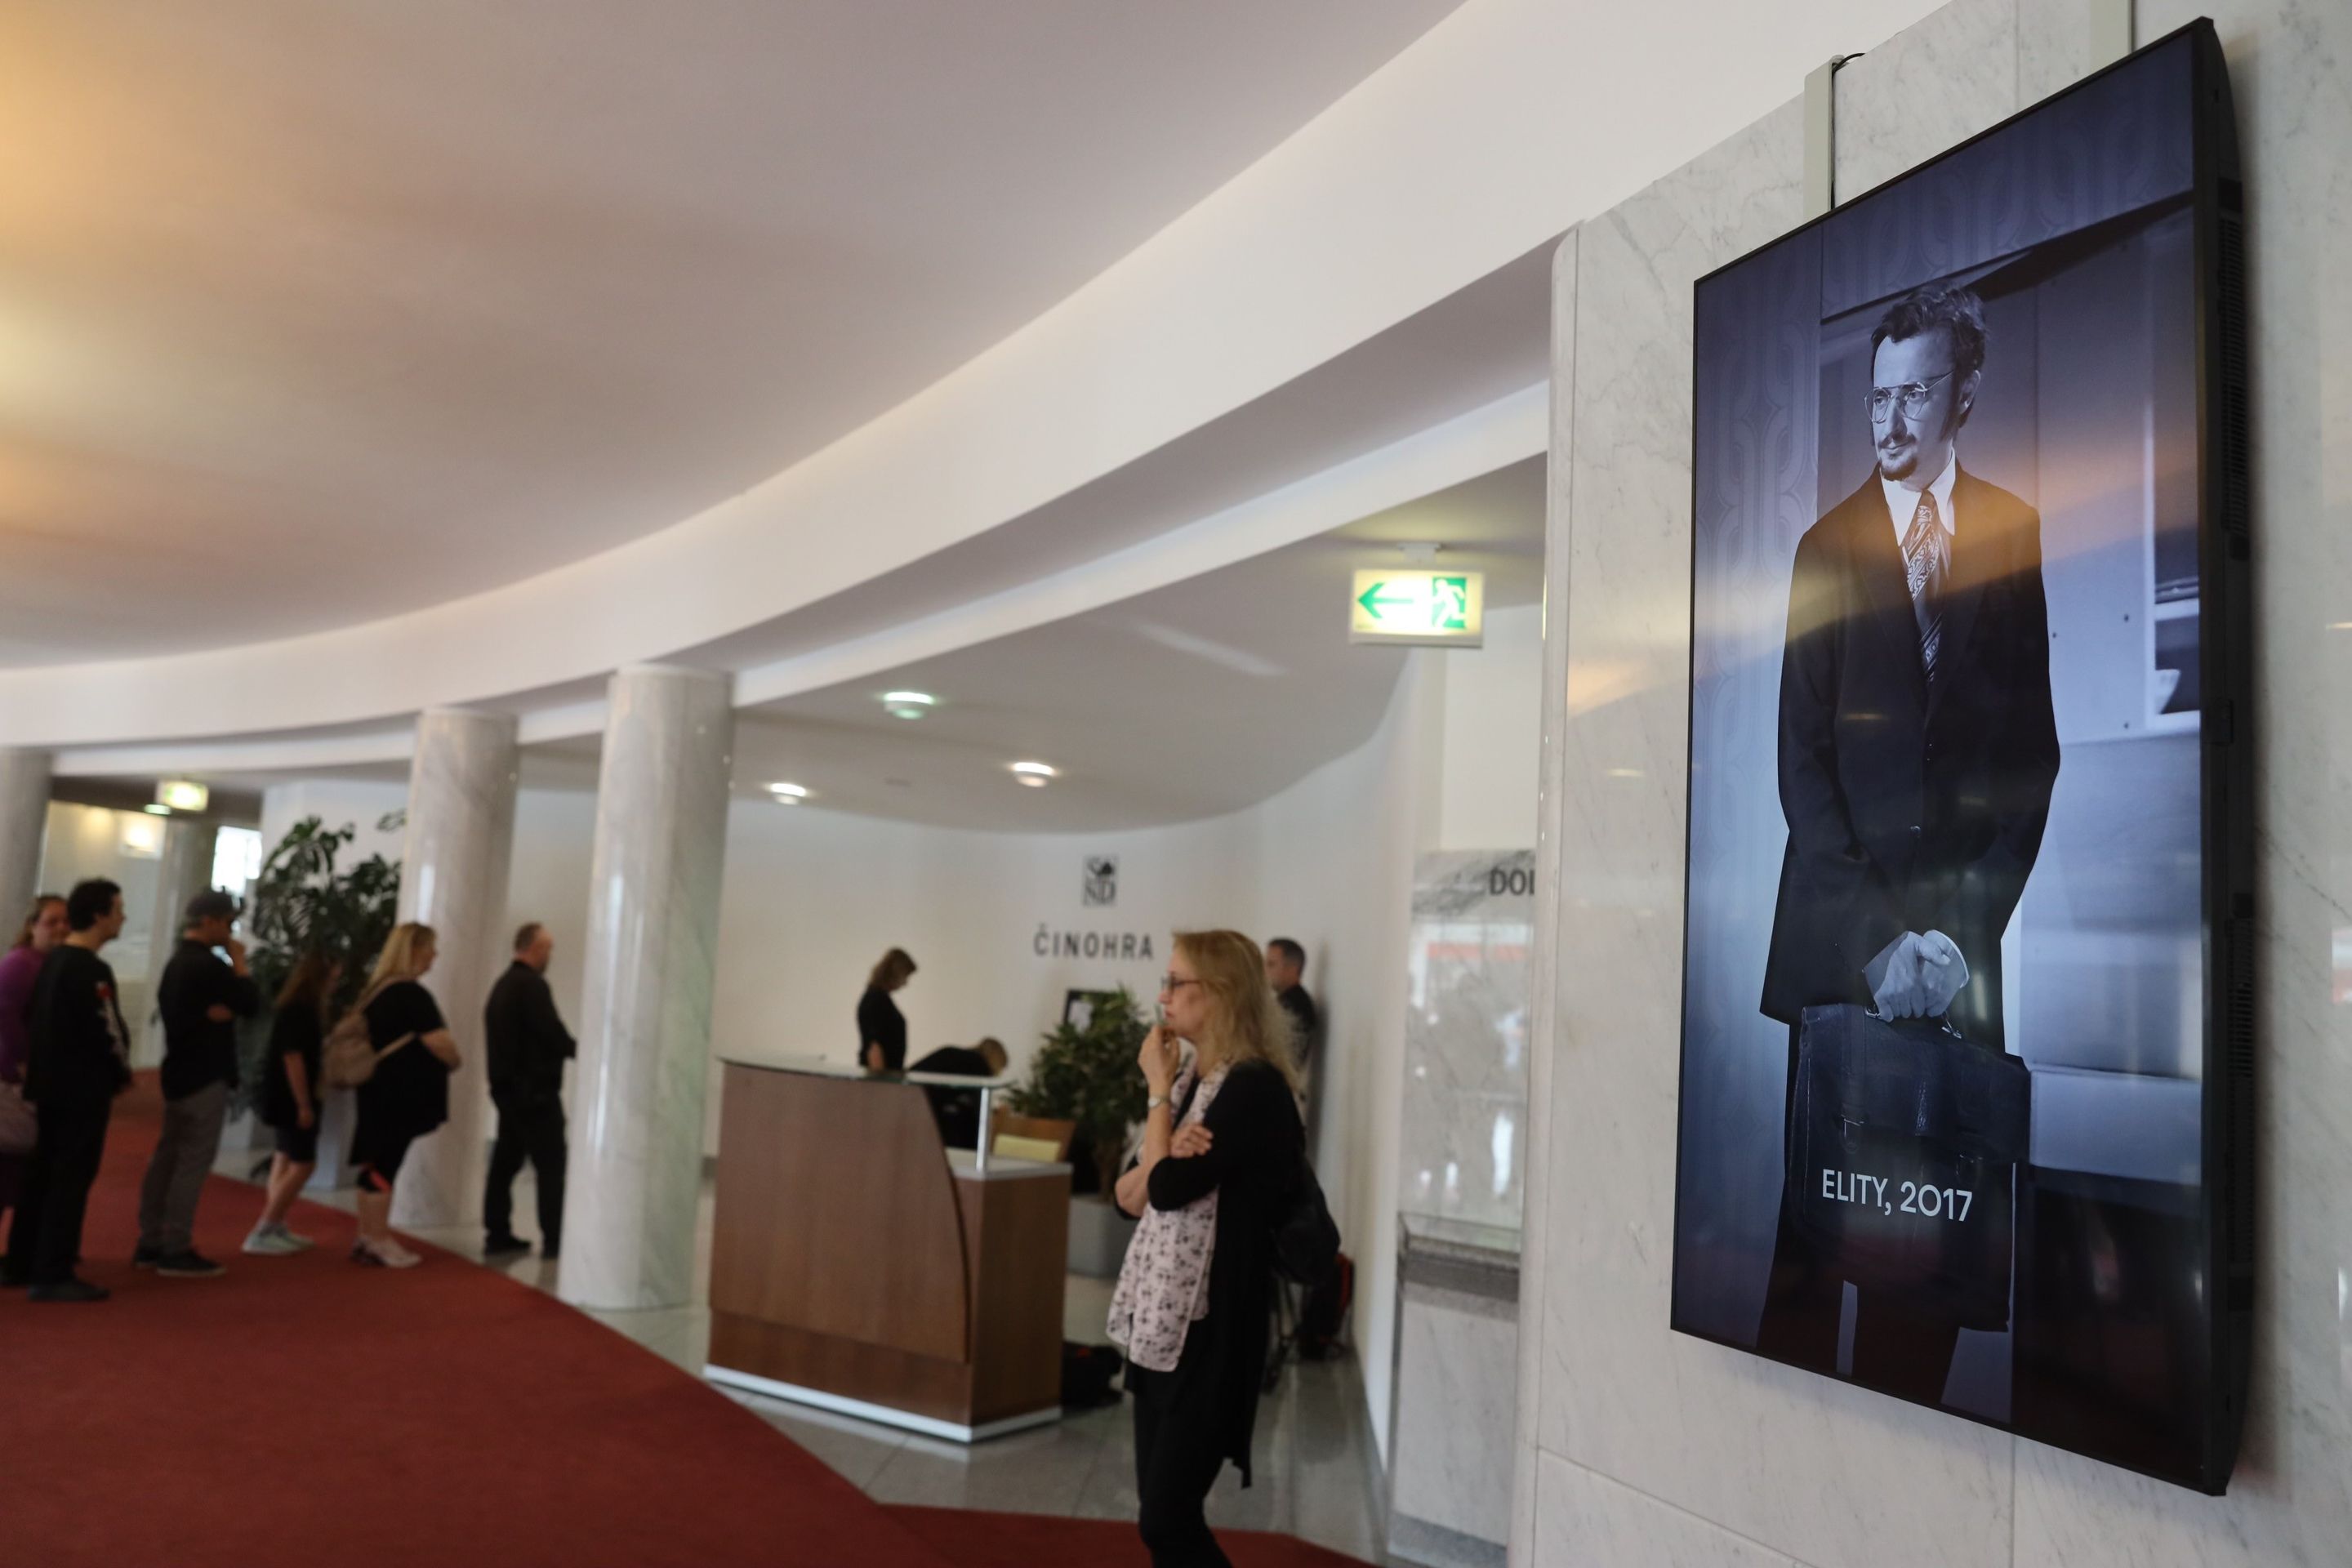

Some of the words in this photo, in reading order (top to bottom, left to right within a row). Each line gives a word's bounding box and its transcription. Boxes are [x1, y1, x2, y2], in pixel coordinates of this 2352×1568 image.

[1033, 923, 1154, 960] ČINOHRA
[1822, 1169, 1891, 1216] ELITY,
[1900, 1181, 1972, 1222] 2017
